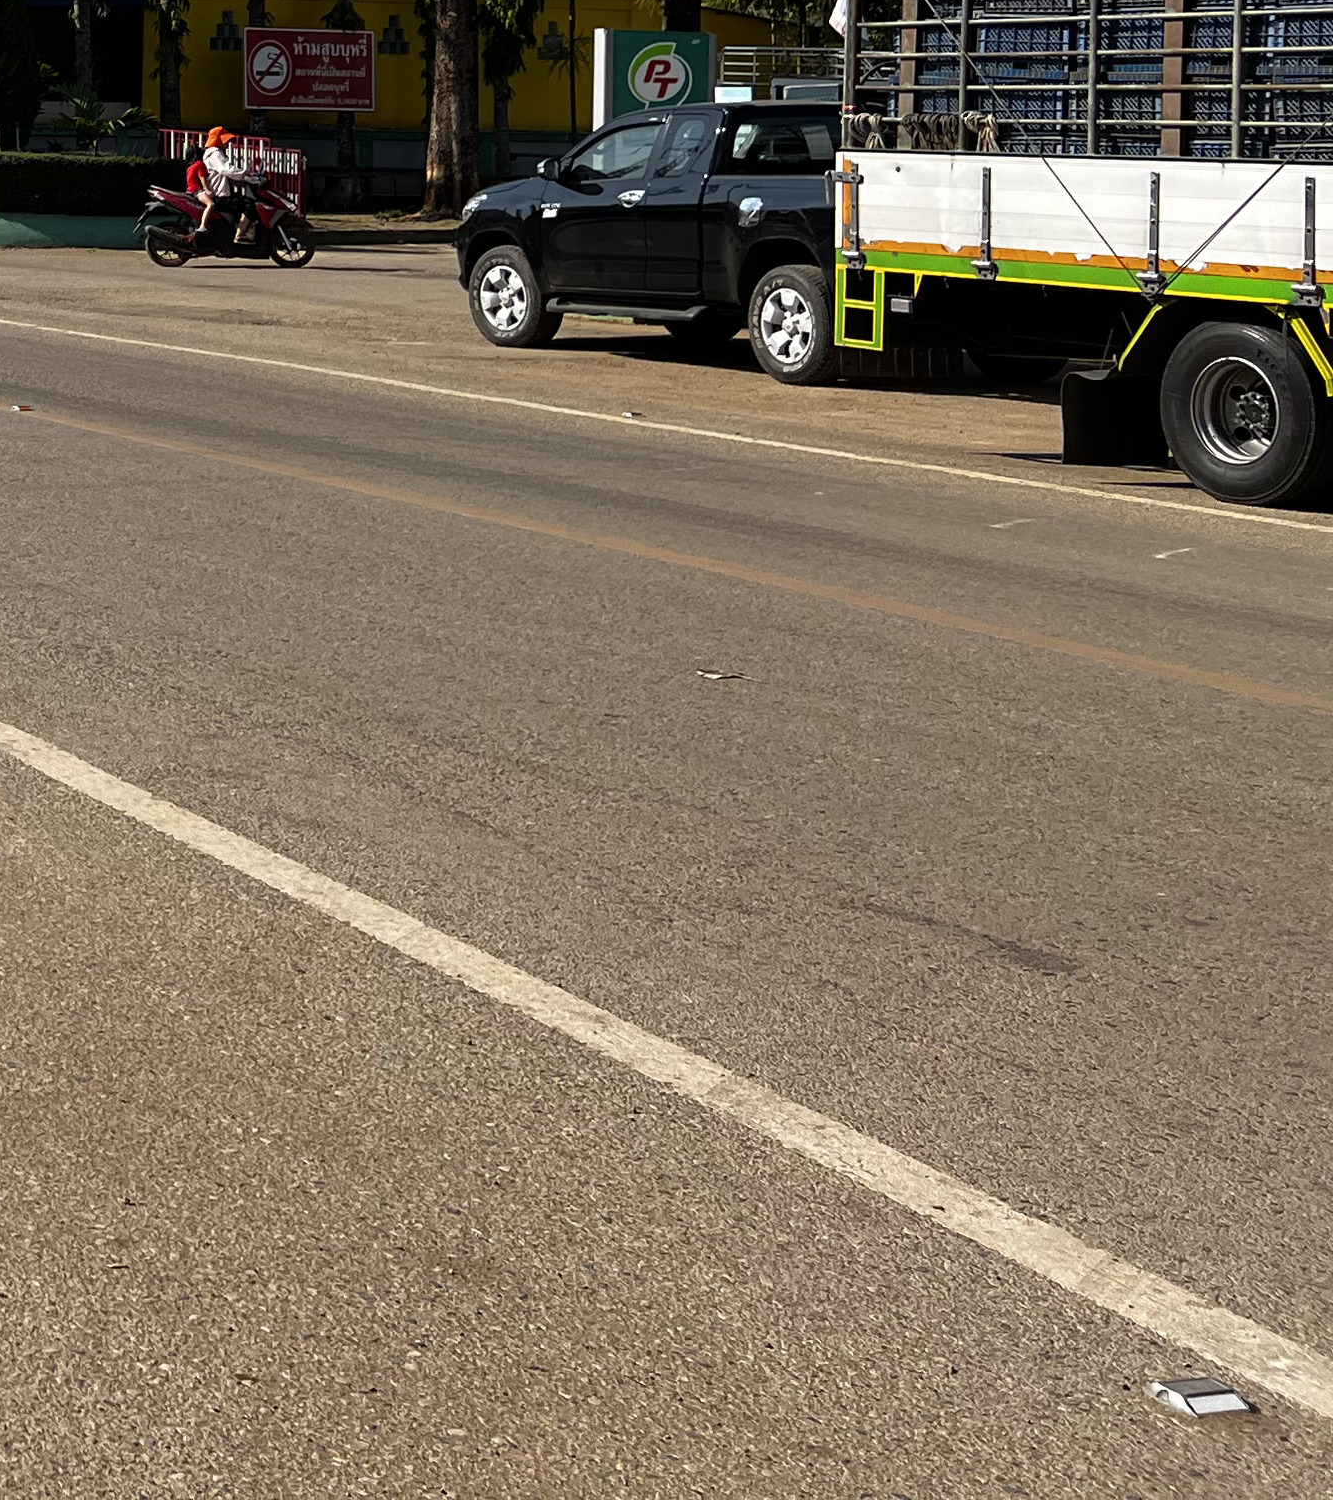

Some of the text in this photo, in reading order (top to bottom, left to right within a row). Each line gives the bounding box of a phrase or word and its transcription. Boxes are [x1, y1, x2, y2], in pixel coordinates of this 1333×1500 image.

[293, 34, 368, 64] ห้ามสูบบุหรี่
[643, 59, 679, 99] PT
